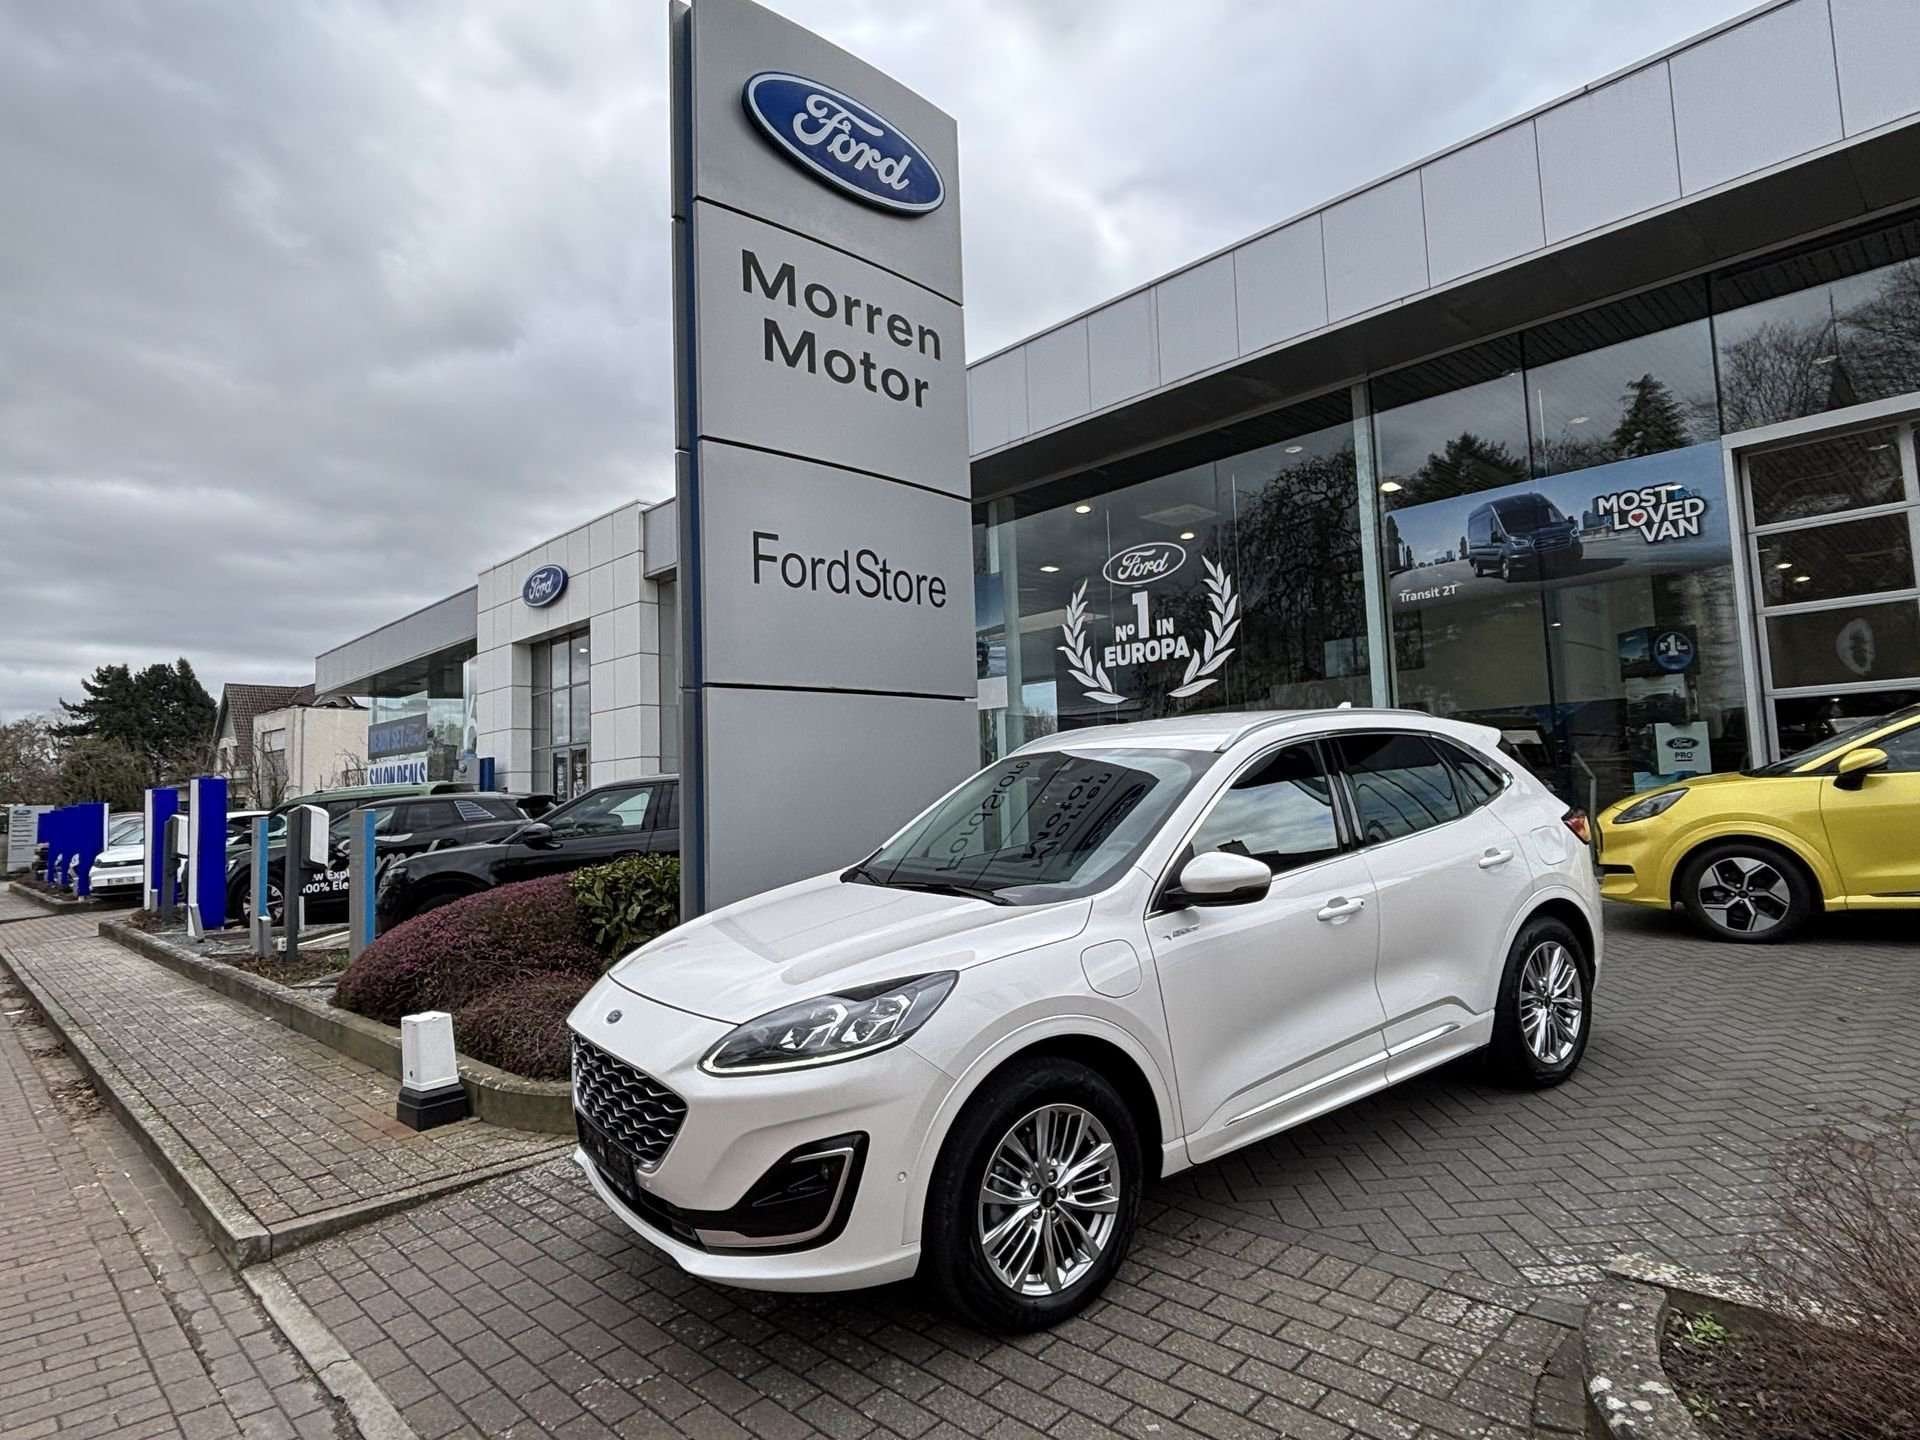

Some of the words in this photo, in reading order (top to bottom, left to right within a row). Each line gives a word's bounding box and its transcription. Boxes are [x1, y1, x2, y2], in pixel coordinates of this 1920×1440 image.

[793, 92, 912, 191] Ford
[742, 248, 941, 361] Morren
[764, 317, 929, 409] Motor
[1598, 484, 1674, 515] MOST
[1613, 497, 1705, 530] LOVED
[1640, 516, 1699, 543] VAN
[752, 530, 947, 608] FordStore
[1117, 548, 1170, 579] Ford
[528, 571, 554, 599] Ford
[1400, 587, 1440, 603] Transit
[1131, 590, 1150, 639] 1
[1156, 617, 1174, 636] IN
[1104, 635, 1190, 668] EUROPA
